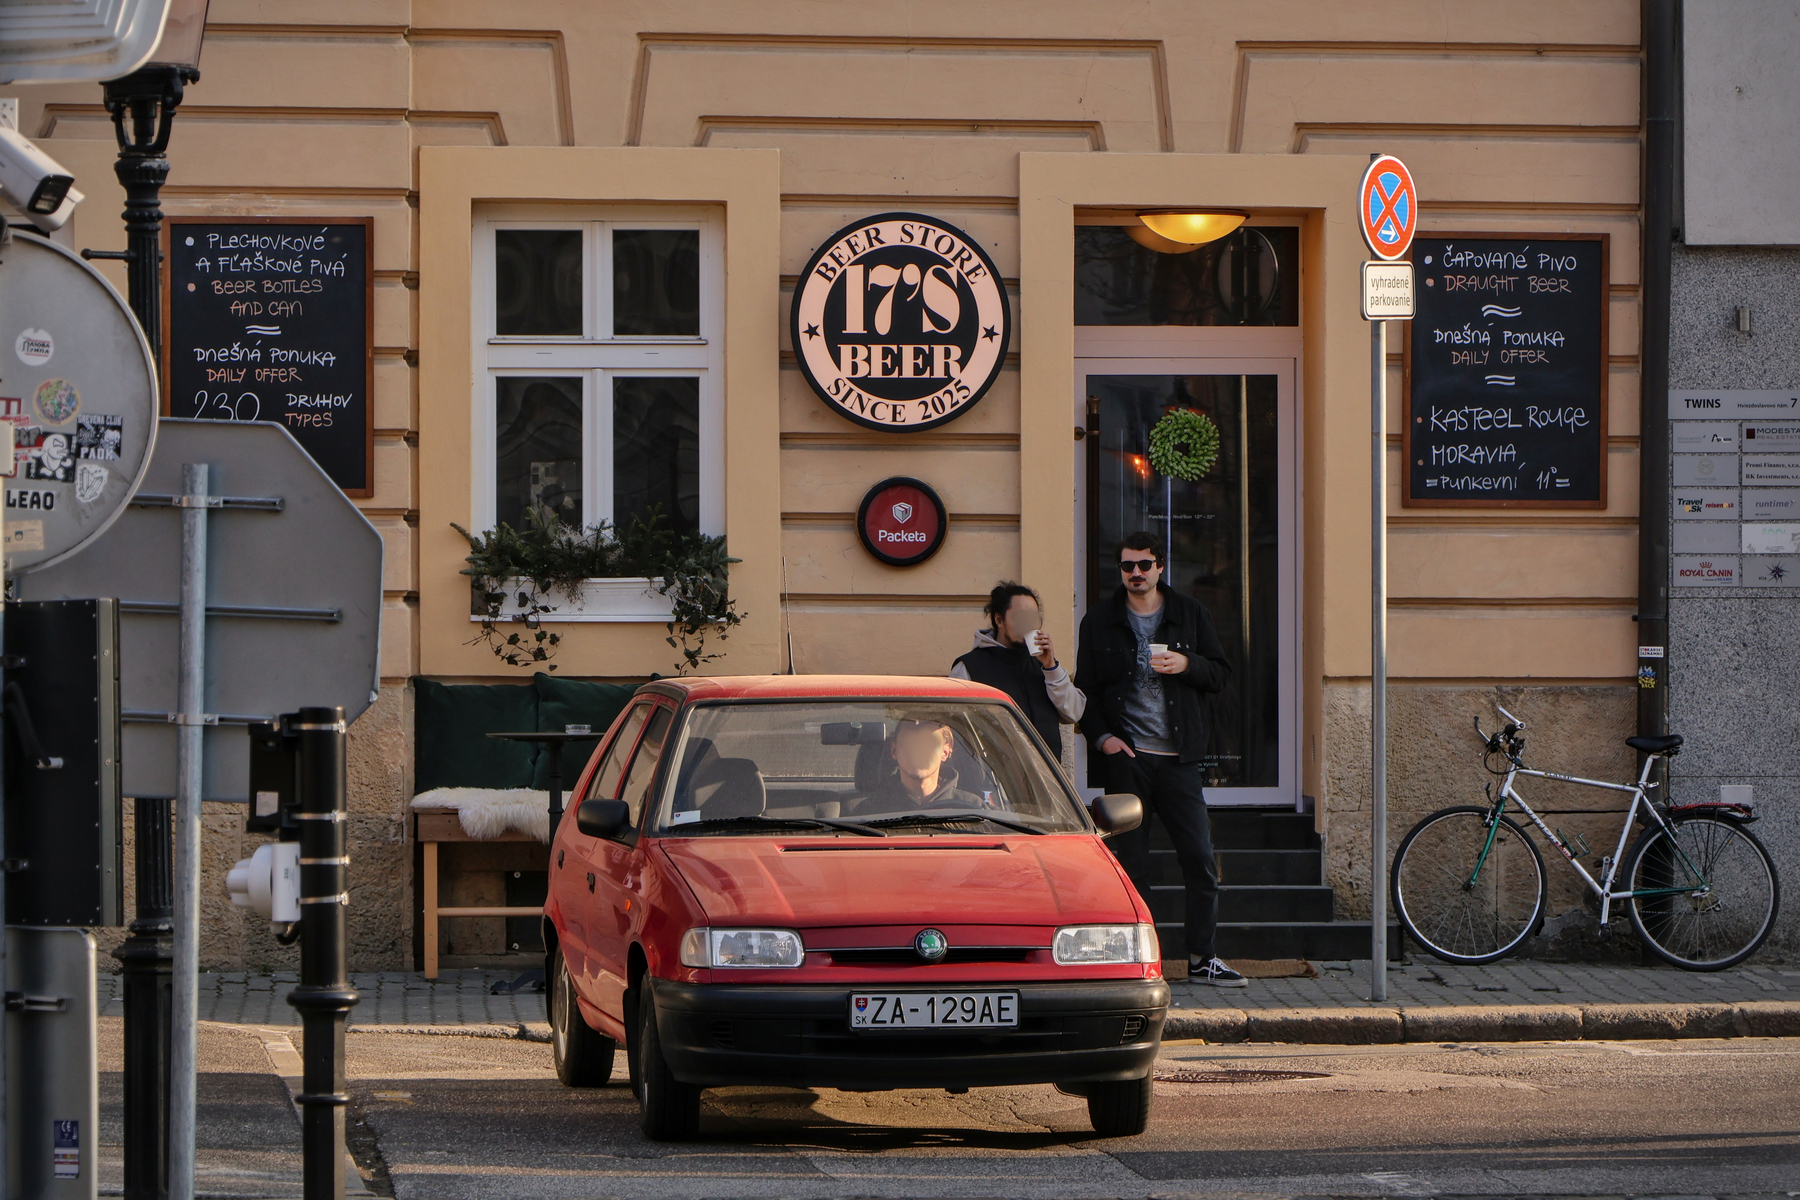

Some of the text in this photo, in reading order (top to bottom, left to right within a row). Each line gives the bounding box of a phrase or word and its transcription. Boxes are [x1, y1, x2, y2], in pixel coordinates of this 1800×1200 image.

[814, 224, 987, 285] BEER STORE
[1537, 253, 1577, 272] PIVO
[195, 258, 211, 273] A
[310, 253, 348, 277] PIVÁ
[1371, 276, 1409, 291] vyhradené
[841, 263, 961, 336] 17'S
[1370, 294, 1410, 308] parkovanie
[837, 344, 962, 379] BEER
[1451, 350, 1490, 366] DAILY
[206, 368, 247, 383] DAILY
[194, 390, 352, 421] 230 DRUHOV
[827, 377, 971, 423] SINCE 2025
[1684, 398, 1721, 409] TWINS
[1790, 397, 1798, 408] 7
[1432, 444, 1516, 466] MORAVIA
[6, 489, 55, 511] LEAO
[1755, 499, 1790, 508] runtime
[878, 529, 926, 542] Packeta
[1680, 569, 1733, 577] ROYAL CANIN
[871, 995, 1014, 1025] ZA-129AE
[855, 1015, 867, 1025] SK
